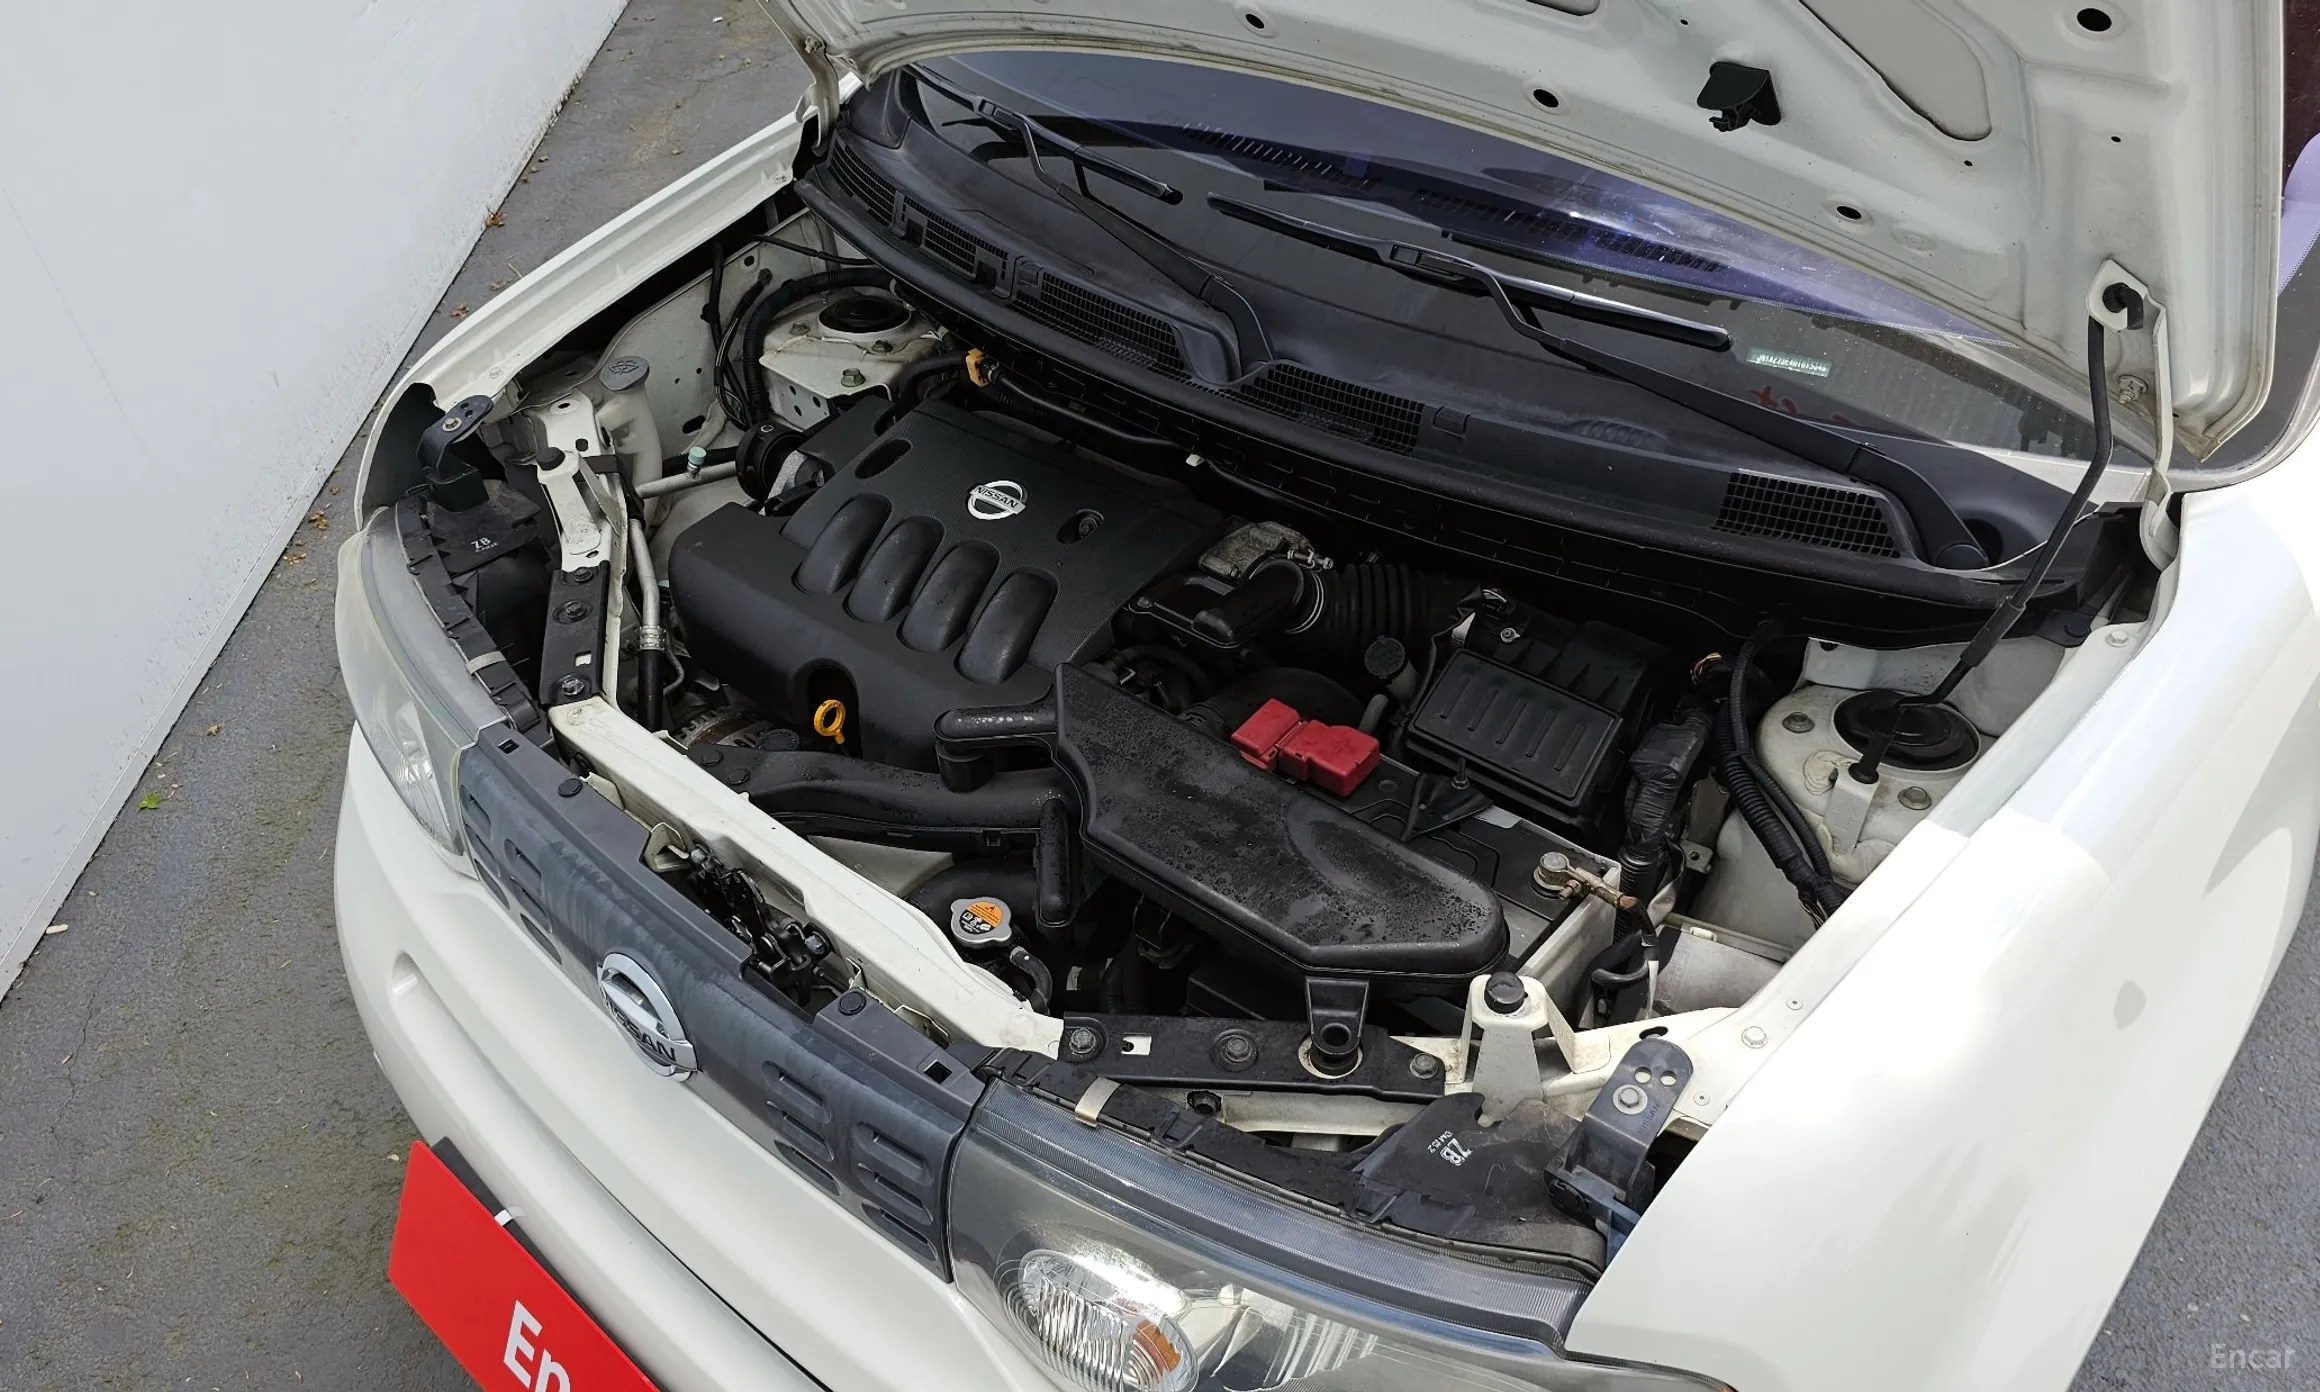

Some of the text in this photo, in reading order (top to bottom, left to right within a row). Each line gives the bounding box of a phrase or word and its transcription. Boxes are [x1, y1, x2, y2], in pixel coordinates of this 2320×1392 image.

[974, 487, 1019, 509] NISSAN
[470, 537, 491, 550] ZB
[1440, 1138, 1473, 1167] ZB
